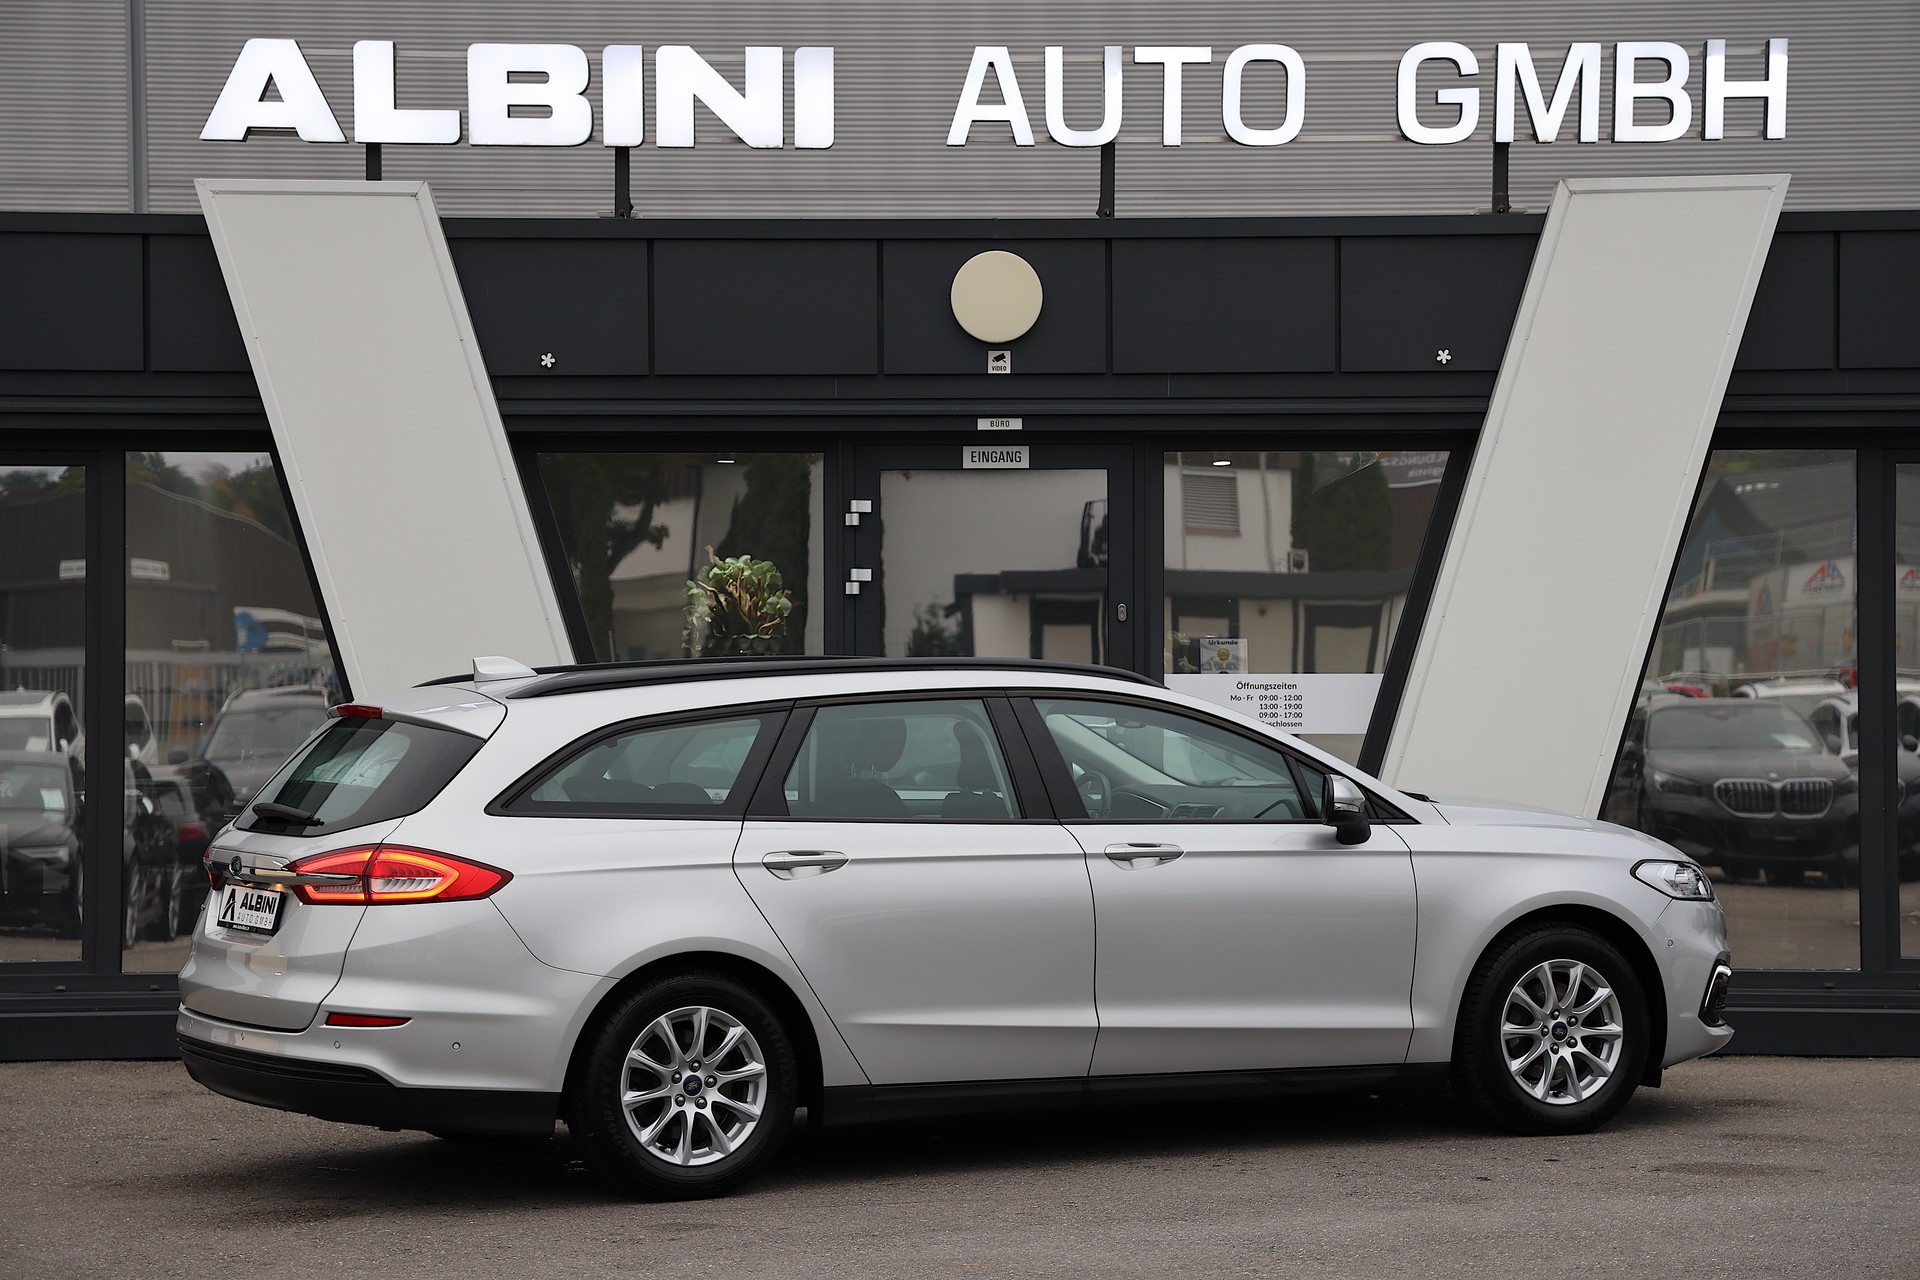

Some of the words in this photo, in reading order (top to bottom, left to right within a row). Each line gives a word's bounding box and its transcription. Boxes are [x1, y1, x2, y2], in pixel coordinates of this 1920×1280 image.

[200, 38, 836, 149] ALBINI
[947, 44, 1306, 147] AUTO
[1397, 38, 1789, 144] GMBH
[990, 419, 1010, 428] BÜRO
[970, 450, 1022, 463] EINGANG
[1236, 680, 1298, 691] Öffnungszeiten
[1230, 694, 1242, 702] Mo
[1246, 694, 1254, 702] Fr
[1258, 694, 1279, 702] 09:00
[1283, 694, 1303, 702] 12:00
[1259, 703, 1279, 711] 13:00
[1283, 703, 1303, 711] 19:00
[1258, 711, 1279, 719] 09:00
[1283, 711, 1303, 719] 17:00
[1261, 720, 1303, 728] schlossen
[240, 892, 277, 915] ALBINI
[237, 912, 253, 924] AUTO
[254, 915, 272, 927] GMBH
